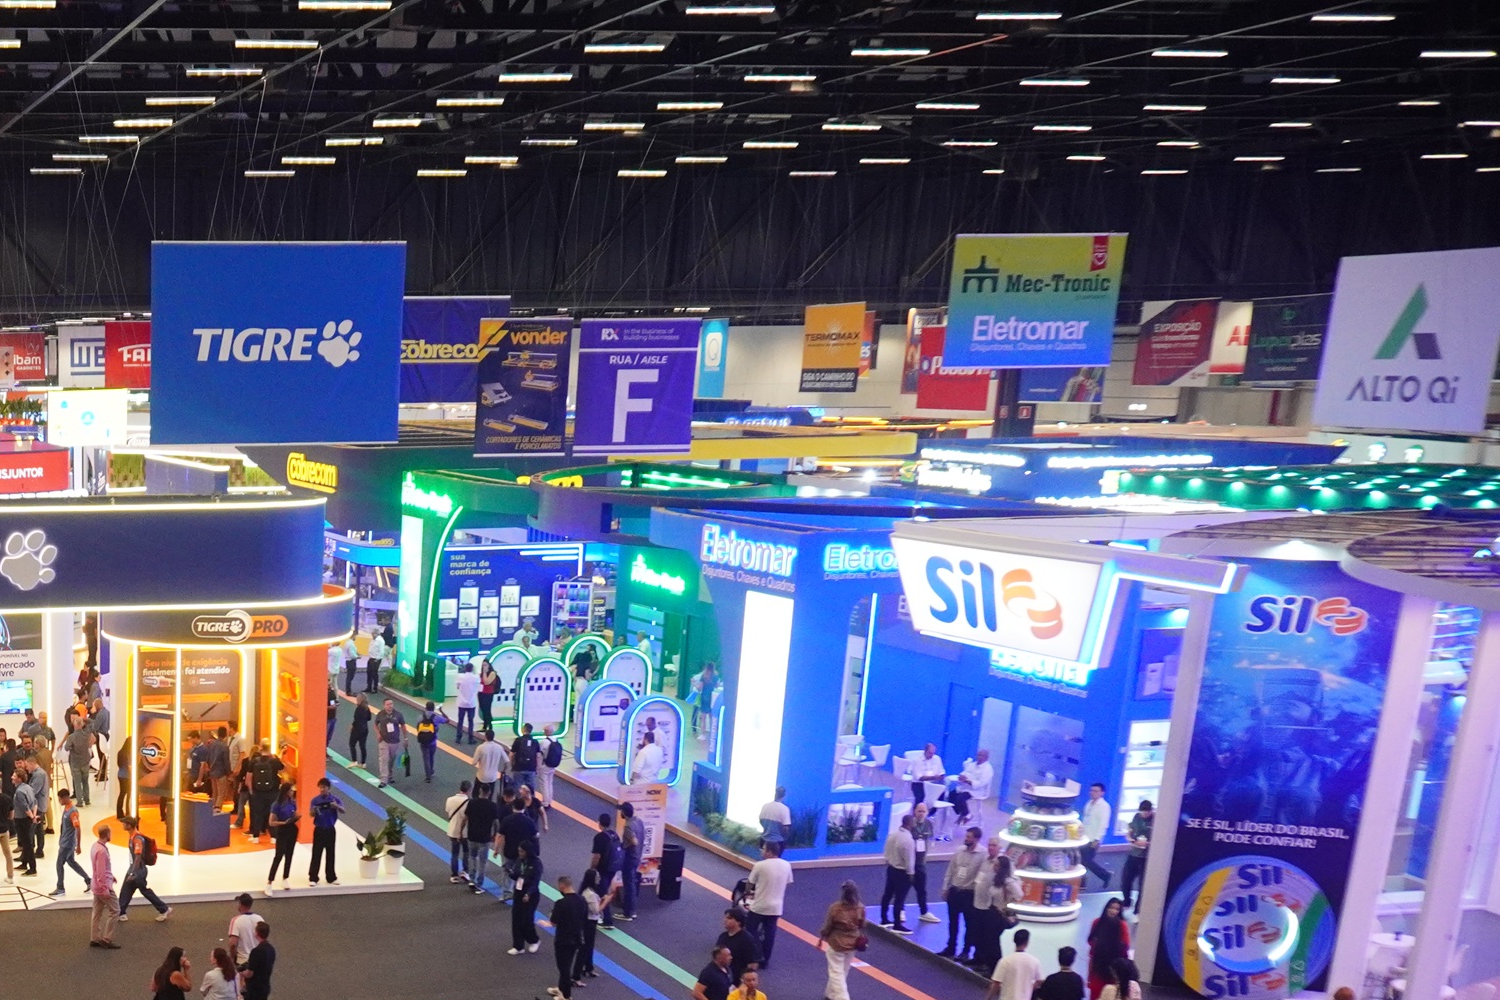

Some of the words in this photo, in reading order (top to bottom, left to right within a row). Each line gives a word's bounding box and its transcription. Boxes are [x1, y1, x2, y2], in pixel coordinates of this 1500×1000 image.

[1005, 274, 1111, 293] Mec-Tronic
[510, 327, 567, 346] vonder
[805, 331, 860, 342] TERMOMAX
[972, 315, 1089, 341] Eletromar
[1154, 321, 1201, 333] EXPOSIÇÃO
[193, 327, 318, 362] TIGRE
[609, 355, 632, 364] RUA
[640, 355, 668, 364] AISLE
[1347, 376, 1421, 402] ALTO
[1427, 377, 1460, 404] Qi
[612, 369, 659, 442] F
[701, 524, 797, 576] Eletromar
[450, 567, 492, 577] confiança
[737, 570, 760, 585] Chaves
[925, 555, 998, 633] Sil
[1246, 595, 1313, 635] Sil
[196, 621, 230, 632] TIGRE
[253, 619, 284, 633] PRO
[185, 667, 196, 675] foi
[196, 667, 230, 675] atendido
[192, 657, 228, 668] exigência
[1186, 818, 1201, 829] SE
[1203, 817, 1212, 829] É
[1237, 820, 1274, 834] LÍDER
[1275, 824, 1298, 835] DO
[1213, 832, 1251, 845] PODE
[1253, 835, 1317, 848] CONFIAR!
[1238, 864, 1283, 889] Sil
[1204, 925, 1245, 951] Sil
[1205, 972, 1249, 999] Sil
